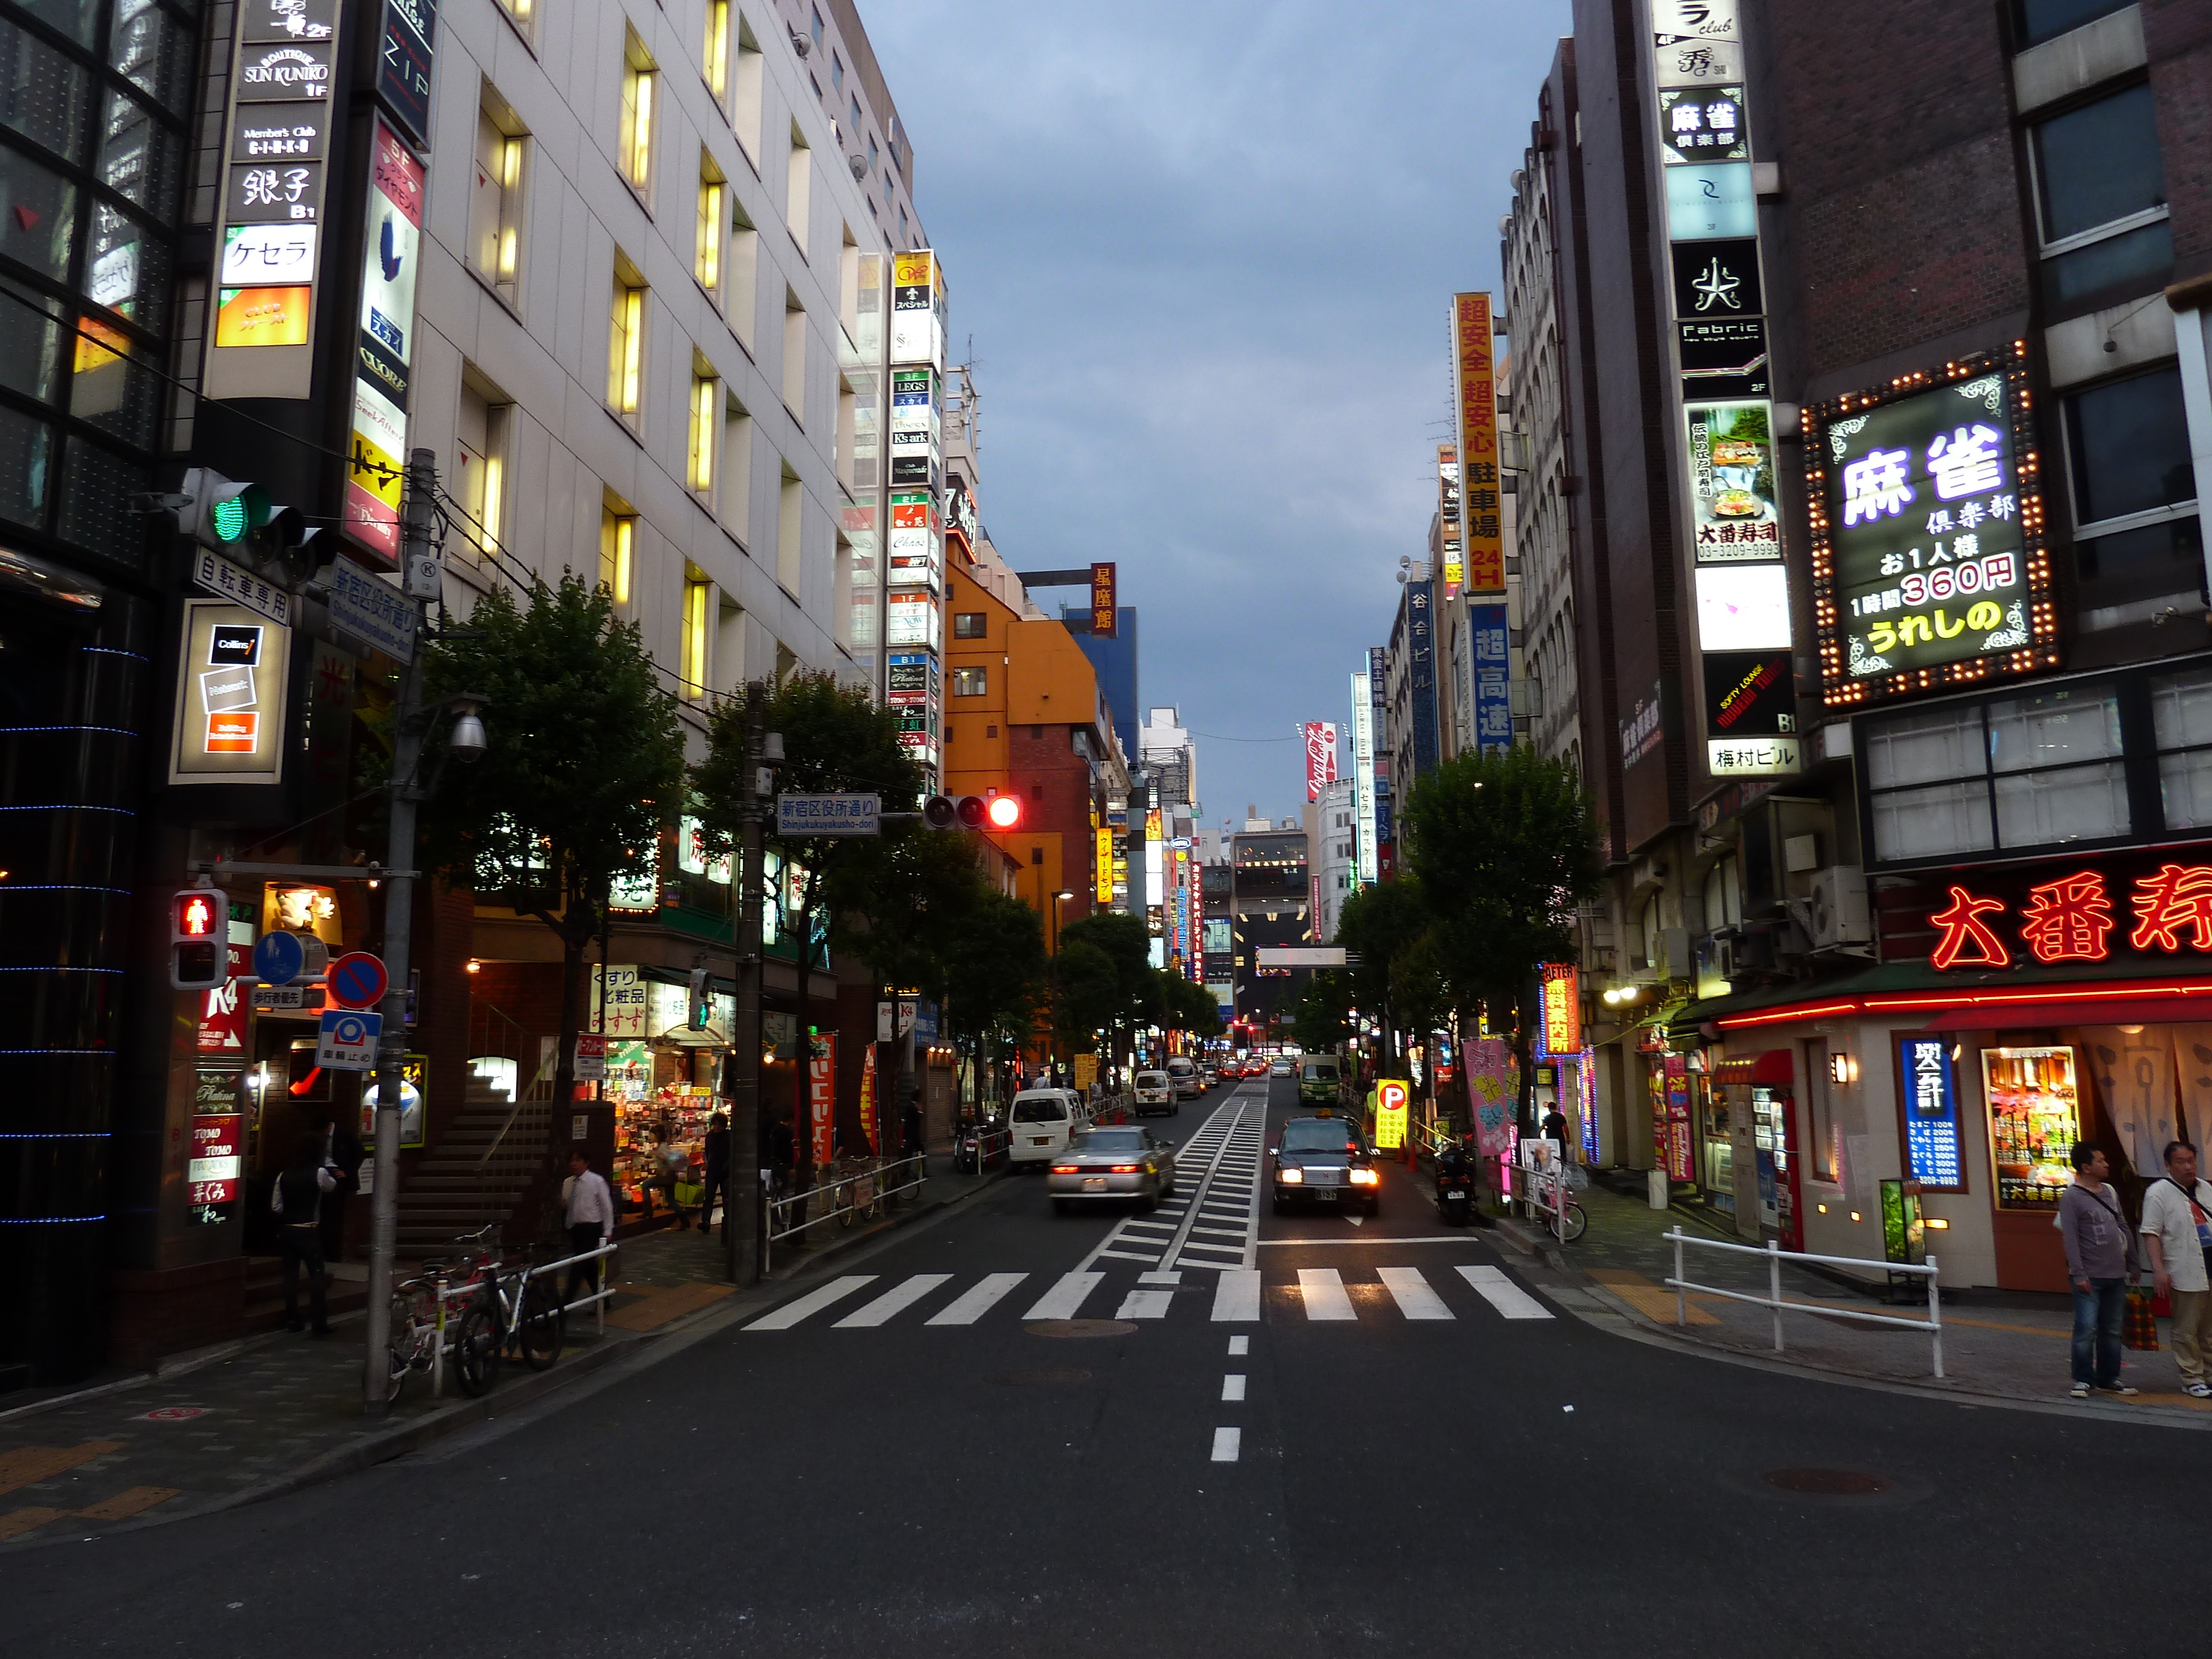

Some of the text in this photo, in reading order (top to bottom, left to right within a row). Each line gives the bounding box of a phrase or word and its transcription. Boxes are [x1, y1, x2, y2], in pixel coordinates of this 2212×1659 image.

[307, 24, 332, 37] 2F
[1699, 18, 1732, 34] club
[1658, 35, 1676, 45] 4F
[260, 49, 316, 67] BOUTIQUE
[384, 34, 429, 96] ZIP
[244, 66, 328, 86] SUN KUNIKO
[305, 84, 328, 96] 1F
[1671, 103, 1736, 132] 麻雀
[243, 127, 316, 139] Member's Club
[390, 138, 411, 166] 5F
[1666, 154, 1677, 162] 3F
[243, 168, 310, 206] 銀子
[375, 165, 419, 217] ダイヤモンド
[290, 205, 315, 219] B1
[1707, 223, 1717, 231] 3F
[232, 242, 306, 268] ケセラ
[246, 303, 280, 318] CLUB
[896, 300, 929, 309] スペシャル
[1459, 299, 1489, 373] 超安全
[1683, 323, 1759, 337] Fabric
[359, 347, 406, 391] CUORE
[898, 382, 926, 392] LEGS
[1750, 383, 1766, 392] 2F
[898, 397, 924, 405] スカイ
[1463, 380, 1495, 454] 超安心
[909, 432, 927, 443] ark
[353, 439, 399, 492] ドン
[1842, 424, 2002, 528] 麻雀
[1467, 462, 1499, 539] 駐車場
[1925, 494, 2016, 535] 倶楽部
[1698, 520, 1778, 544] 大番寿司
[893, 536, 925, 548] Chaos
[1699, 543, 1780, 559] 03-3209-9993
[1880, 533, 1979, 577] お1人様
[202, 555, 286, 619] 自転車専用
[337, 566, 414, 633] 新宿区役所通り
[1094, 568, 1113, 629] 星座館
[1867, 601, 2001, 654] うれしの
[218, 639, 249, 649] Collins
[1412, 593, 1433, 689] 谷合ビル
[1740, 663, 1765, 690] LOUNGE
[1777, 713, 1796, 732] B1
[1715, 746, 1795, 768] 梅村ビル
[1360, 784, 1369, 812] パセラ
[782, 800, 874, 817] 新宿区役所通り
[781, 819, 875, 830] Shinjukukuyakusho-dori
[1362, 828, 1371, 875] カスケード
[594, 971, 635, 986] くすり
[1545, 966, 1573, 979] AFTER
[254, 992, 299, 1004] 歩行者優先
[1546, 979, 1569, 1052] 無料案内所
[322, 1049, 371, 1062] 車輪止め
[196, 1084, 236, 1102] Platina
[1385, 1087, 1404, 1108] P
[194, 1128, 221, 1139] TOMO
[205, 1145, 232, 1156] TOMO
[194, 1181, 226, 1202] 芽ぐみ
